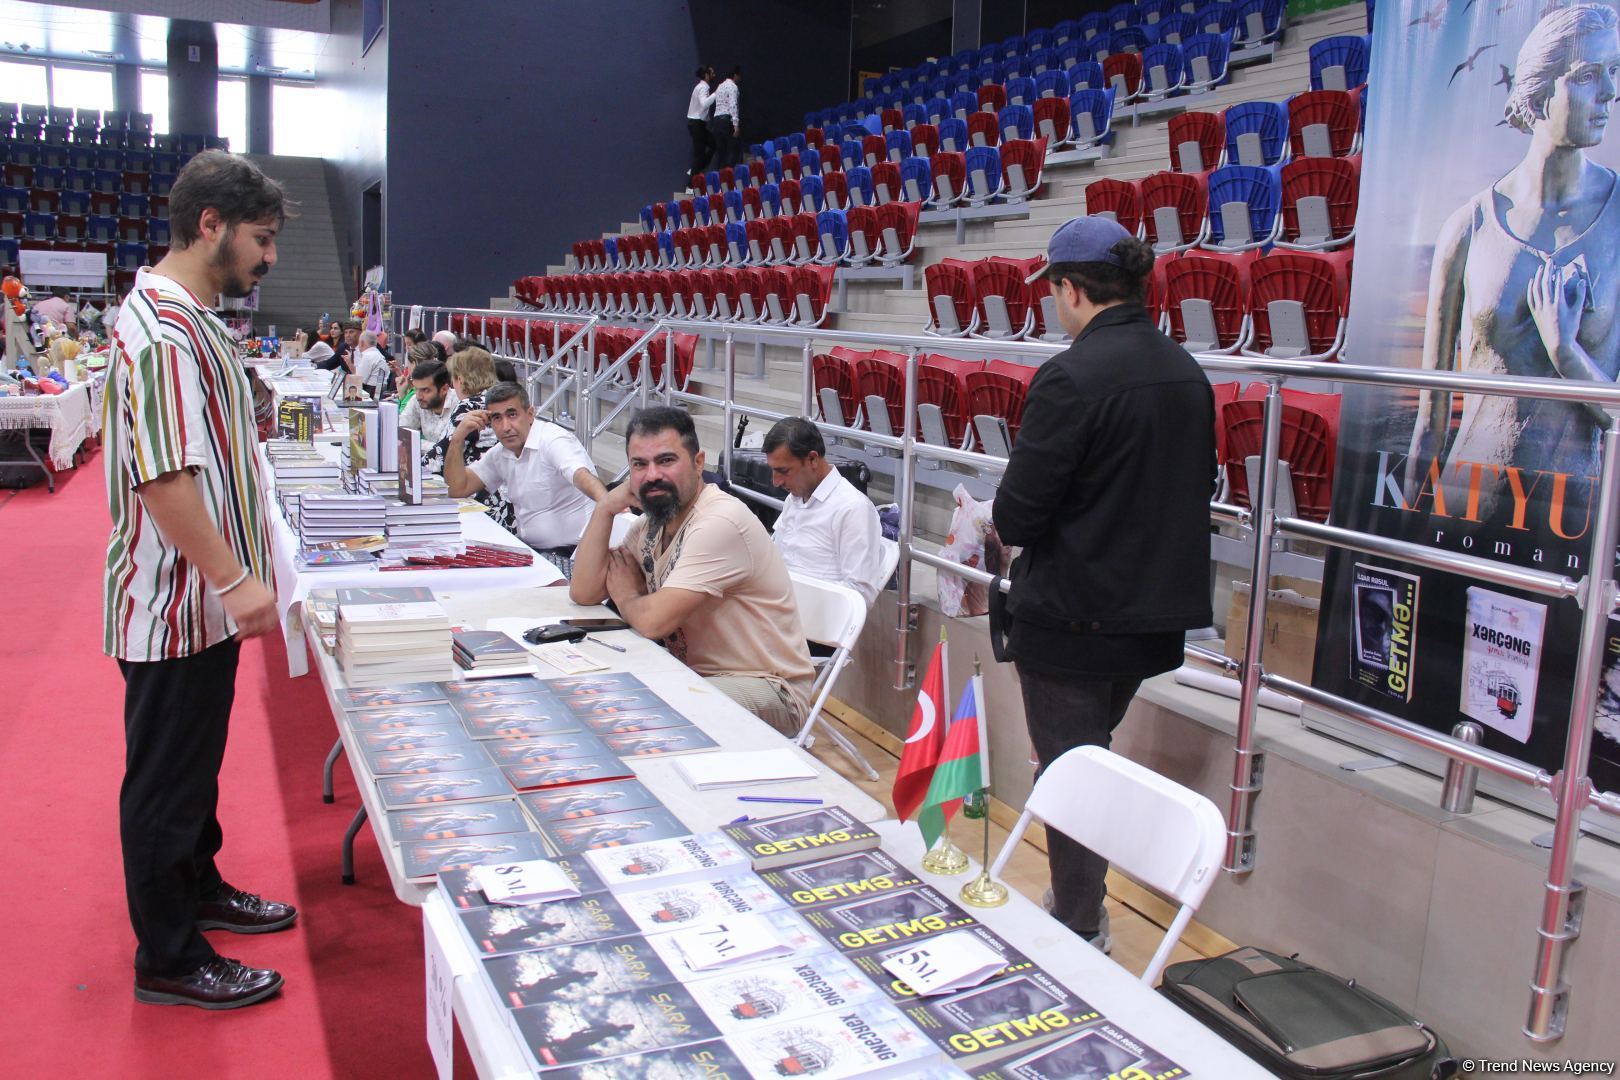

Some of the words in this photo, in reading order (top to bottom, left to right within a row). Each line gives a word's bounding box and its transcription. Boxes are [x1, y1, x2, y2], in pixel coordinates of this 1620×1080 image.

[1435, 529, 1580, 569] roman
[1387, 584, 1414, 693] GETMƏ...
[1472, 623, 1532, 657] XƏRÇƏNG
[754, 831, 876, 856] GETMƏ...
[494, 865, 524, 876] 8
[791, 876, 920, 904] GETMƏ...
[582, 898, 615, 932] SARA
[698, 923, 730, 936] 7
[838, 915, 974, 949] GETMƏ...
[615, 943, 651, 982] SARA
[898, 948, 932, 967] 5
[792, 964, 846, 1007] XƏRÇƏNG
[651, 991, 693, 1036] SARA
[839, 1012, 898, 1061] XƏRÇƏNG
[948, 1010, 1099, 1053] GETMƏ...
